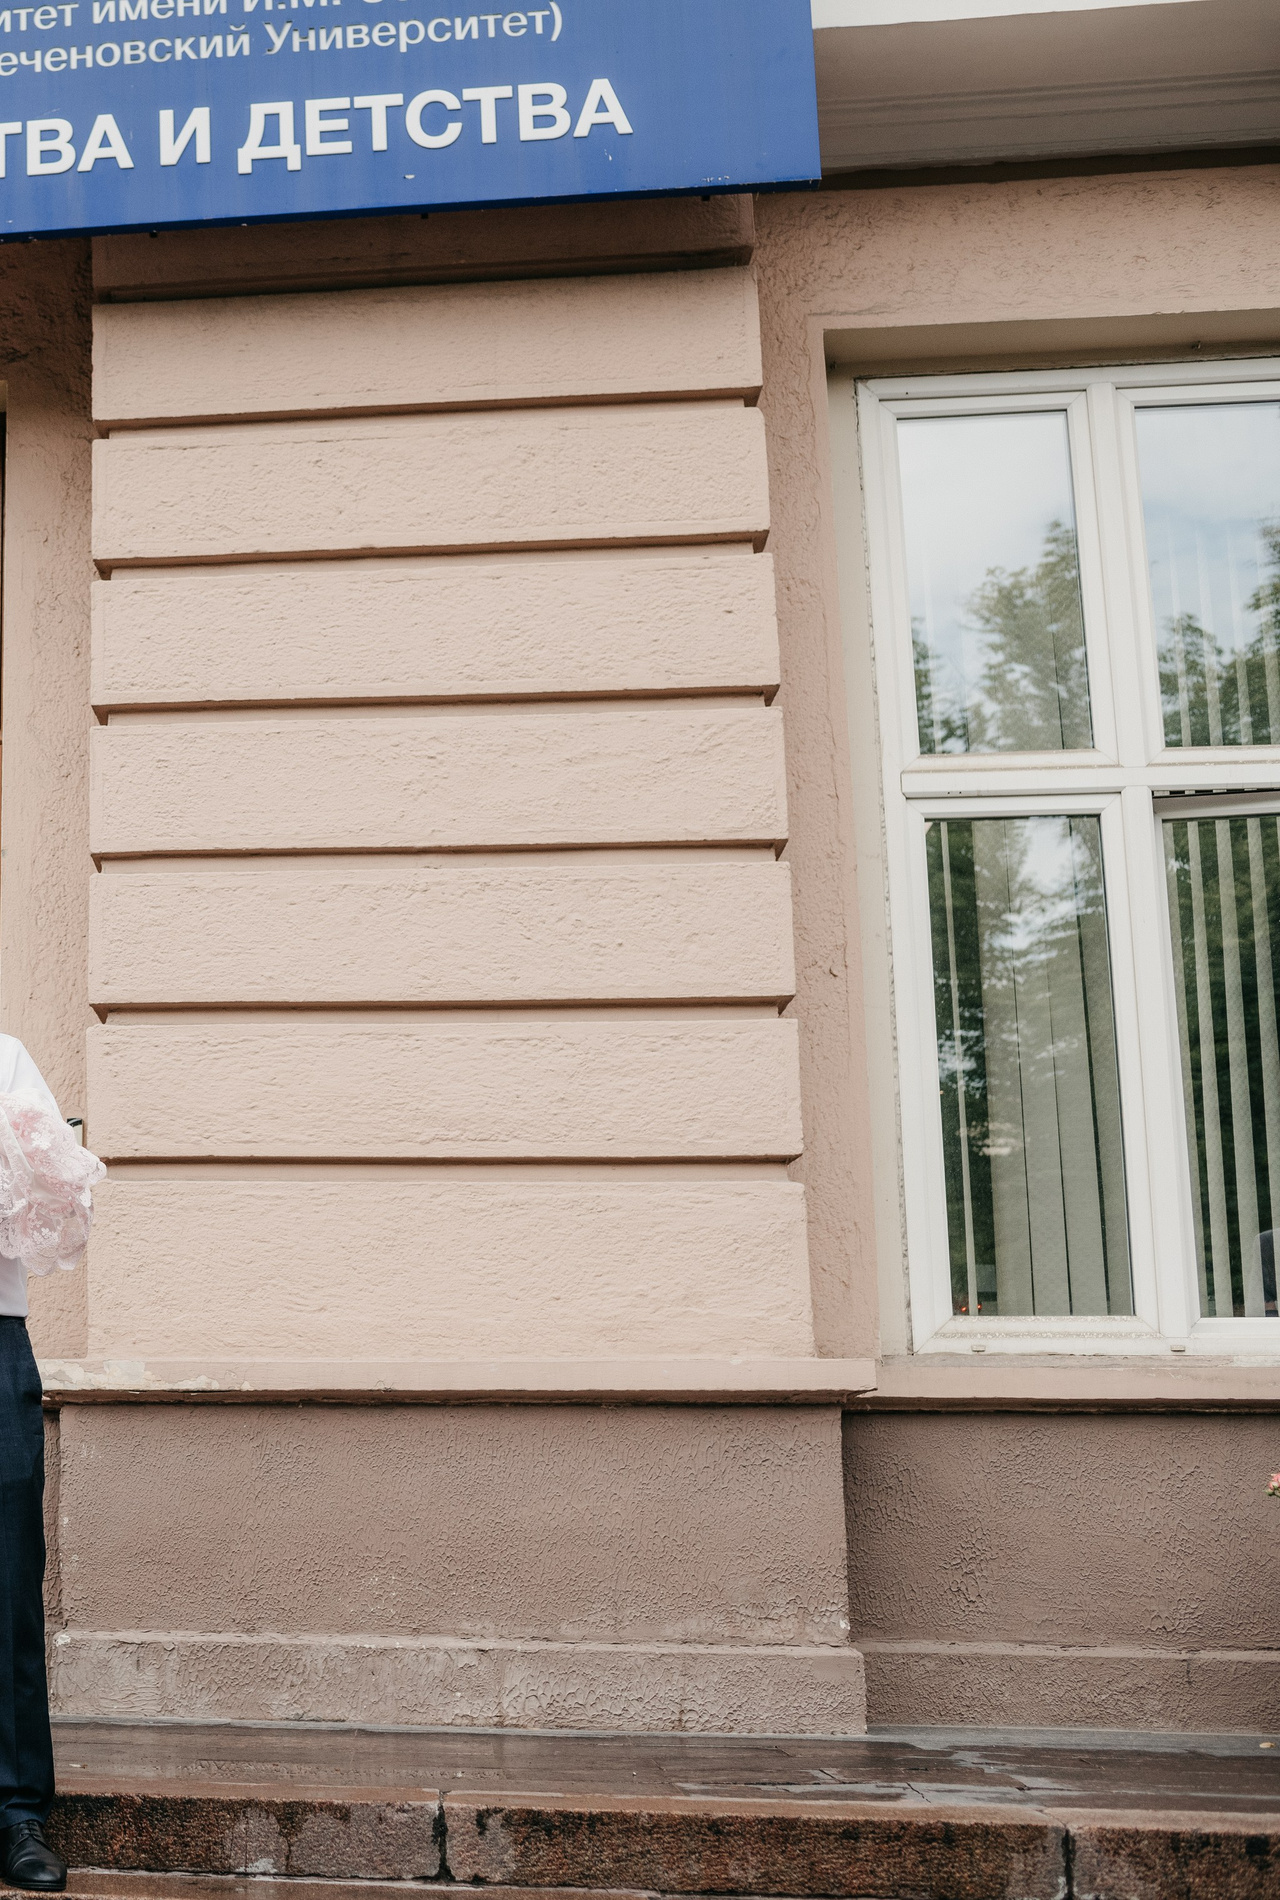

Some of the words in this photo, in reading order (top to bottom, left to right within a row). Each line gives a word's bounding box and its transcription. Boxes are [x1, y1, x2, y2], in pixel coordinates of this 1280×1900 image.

[91, 0, 228, 25] имени
[263, 1, 563, 55] Университет)
[159, 105, 211, 166] И
[237, 77, 634, 174] ДЕТСТВА
